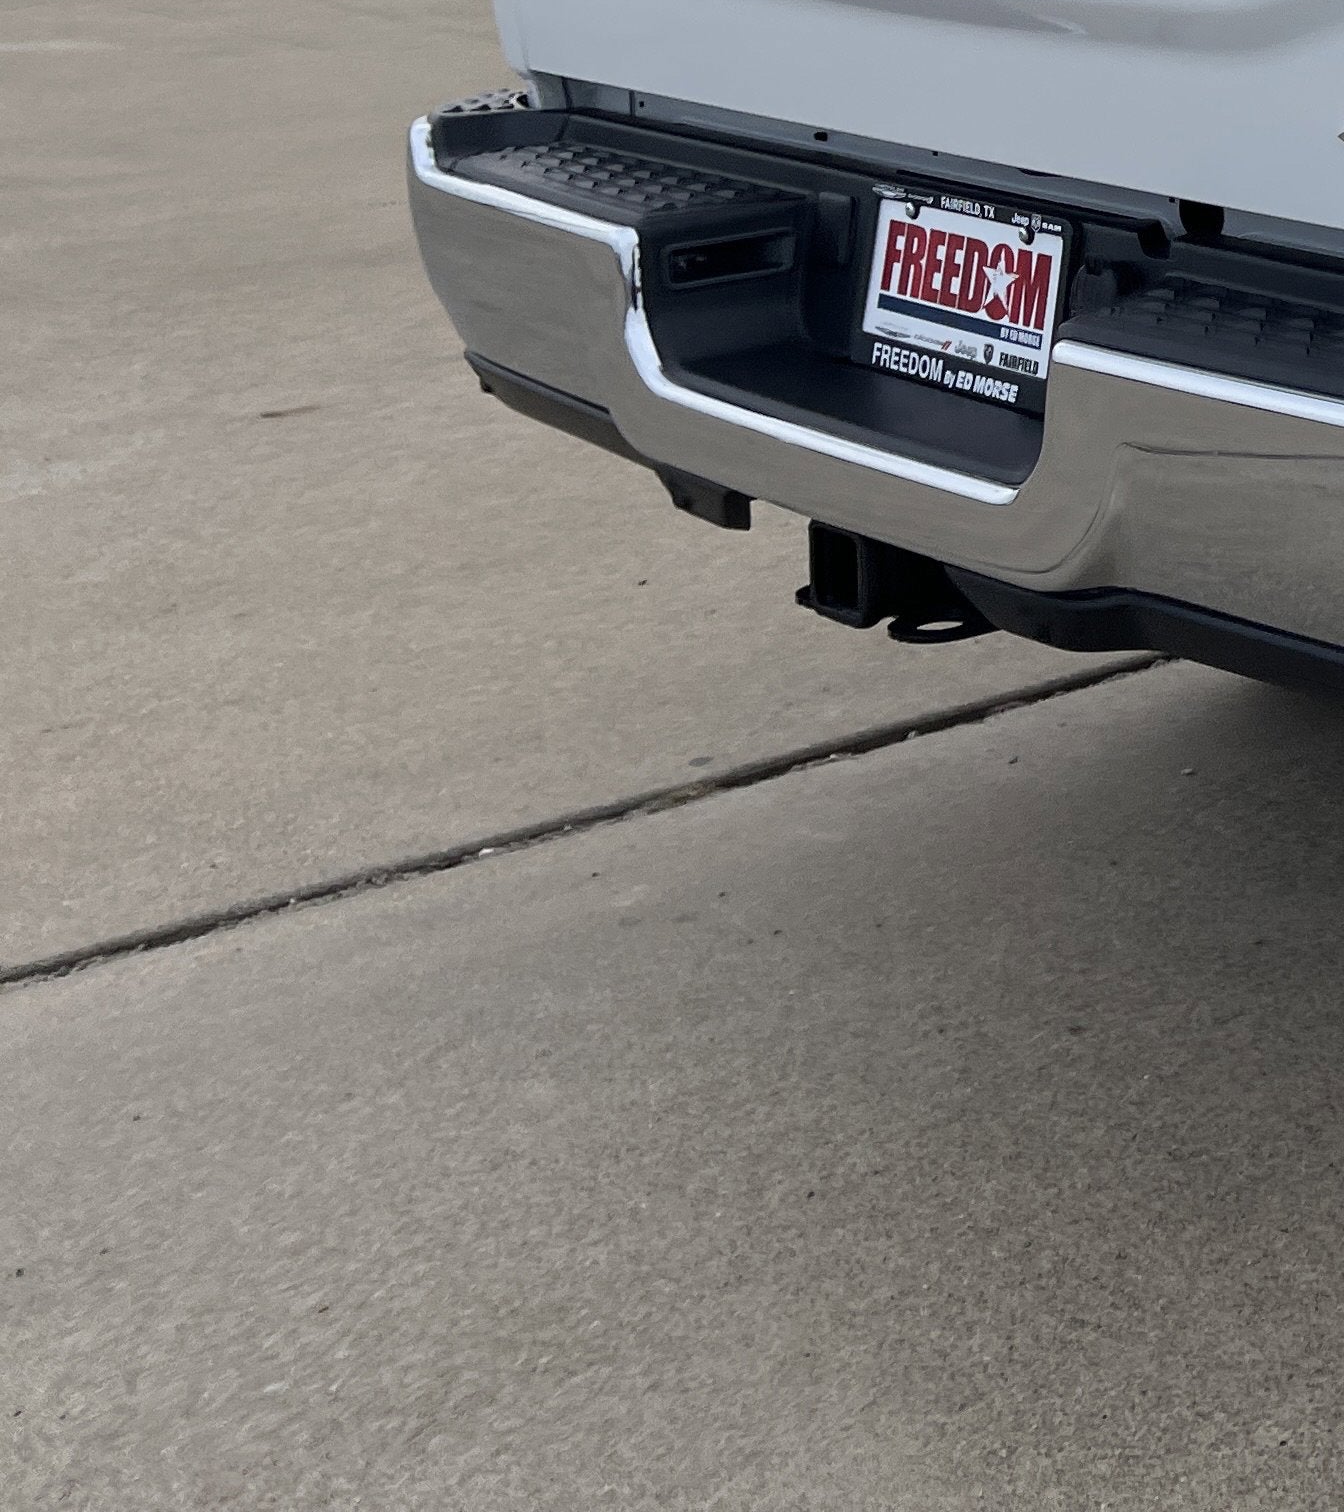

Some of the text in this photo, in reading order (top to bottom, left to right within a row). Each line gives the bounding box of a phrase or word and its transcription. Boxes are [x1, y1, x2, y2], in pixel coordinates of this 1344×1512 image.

[983, 203, 996, 219] TX
[881, 219, 1052, 330] FREEDOM
[872, 342, 944, 383] FREEDOM
[955, 370, 974, 391] ED
[973, 375, 1019, 404] MORSE
